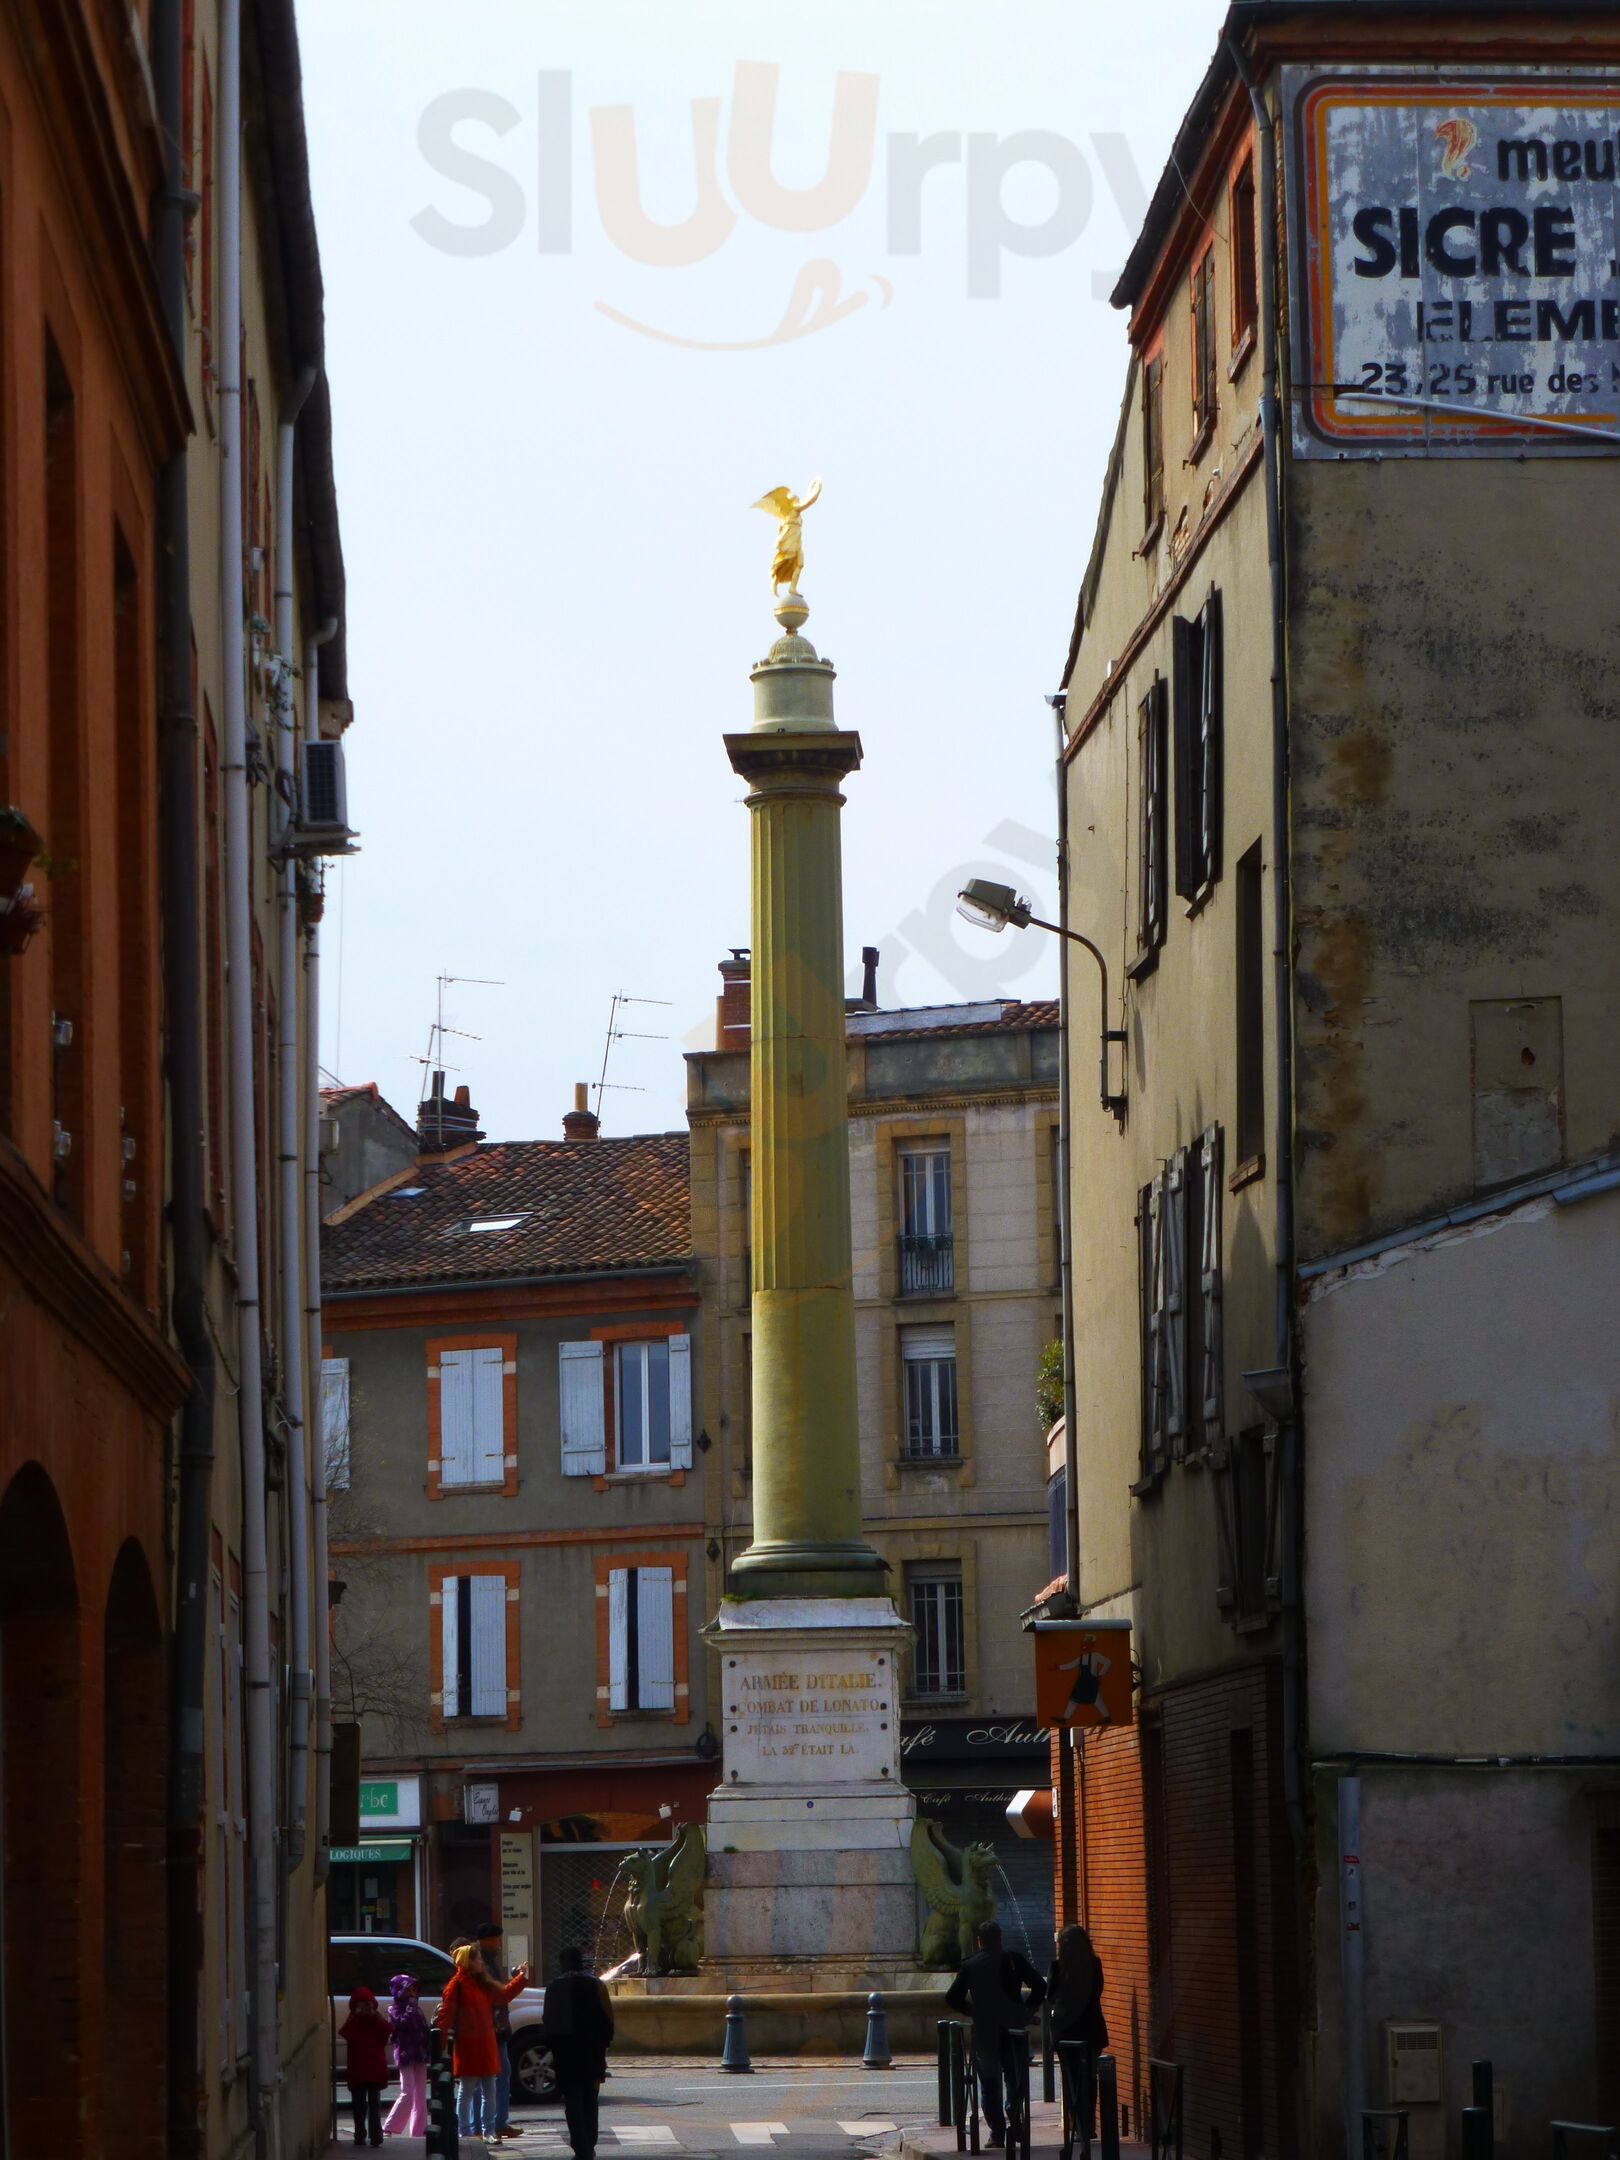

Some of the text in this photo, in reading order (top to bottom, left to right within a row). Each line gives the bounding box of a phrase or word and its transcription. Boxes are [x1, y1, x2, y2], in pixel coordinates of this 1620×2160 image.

[1497, 128, 1620, 182] meu
[1353, 206, 1576, 278] SICRE
[1487, 371, 1535, 395] rue
[1548, 364, 1600, 395] des
[800, 1699, 819, 1713] DE
[900, 1725, 937, 1755] afé
